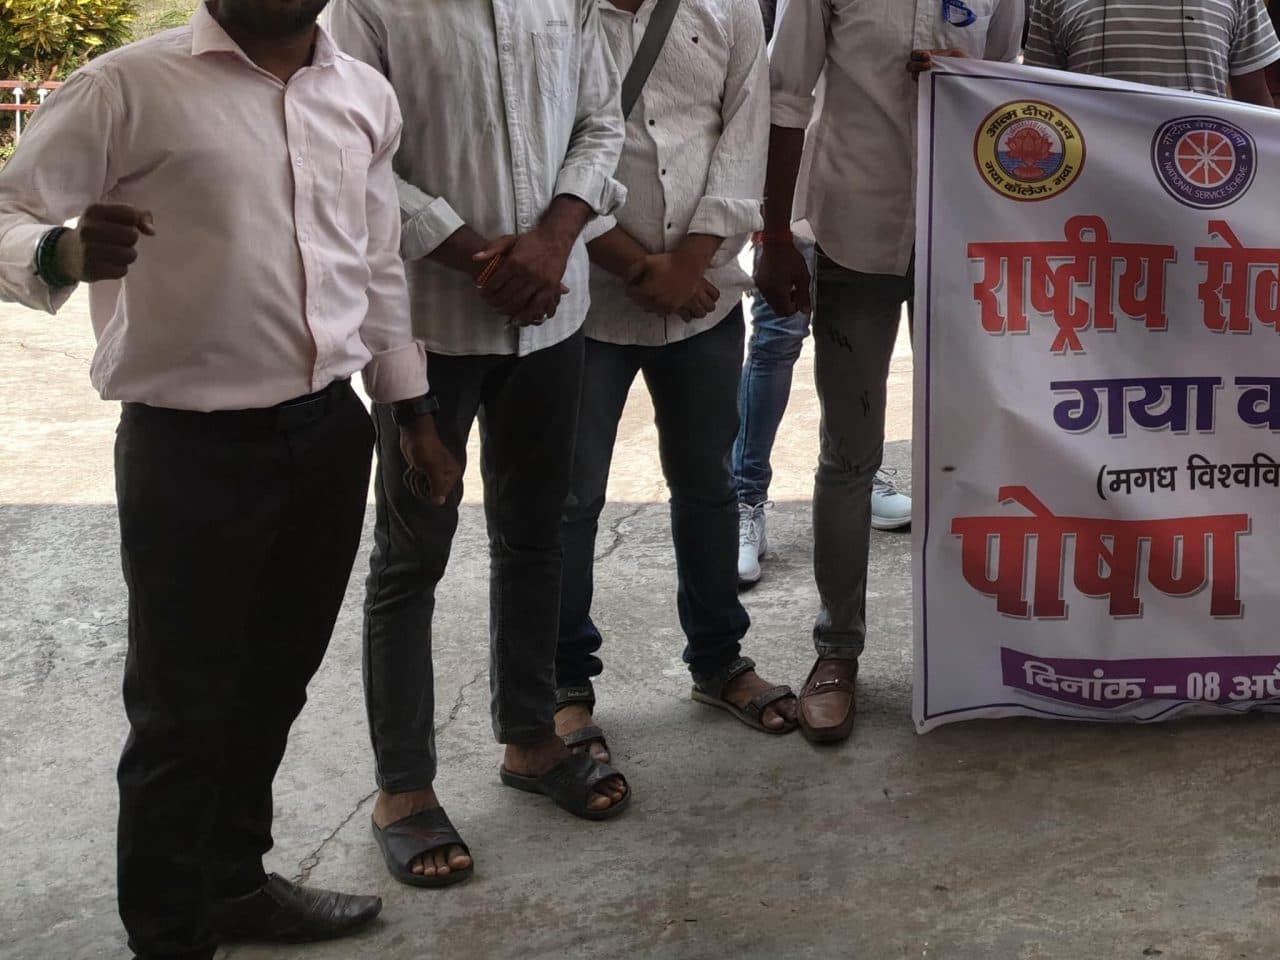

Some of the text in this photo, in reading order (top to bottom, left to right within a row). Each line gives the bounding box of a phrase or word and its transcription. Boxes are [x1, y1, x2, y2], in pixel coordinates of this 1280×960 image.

[987, 109, 1018, 138] आत्म
[1021, 104, 1055, 121] दीपो
[1054, 119, 1075, 140] भव
[985, 160, 1003, 185] गया
[1054, 164, 1074, 186] गया
[1164, 161, 1248, 200] NATIONAL SERVICE SCHEME
[967, 215, 1176, 353] राष्ट्रीय
[1050, 376, 1222, 436] गया
[1097, 465, 1177, 500] (मगध
[951, 486, 1251, 619] पोषण
[1022, 661, 1146, 701] दिनांक
[1187, 672, 1220, 701] 08
